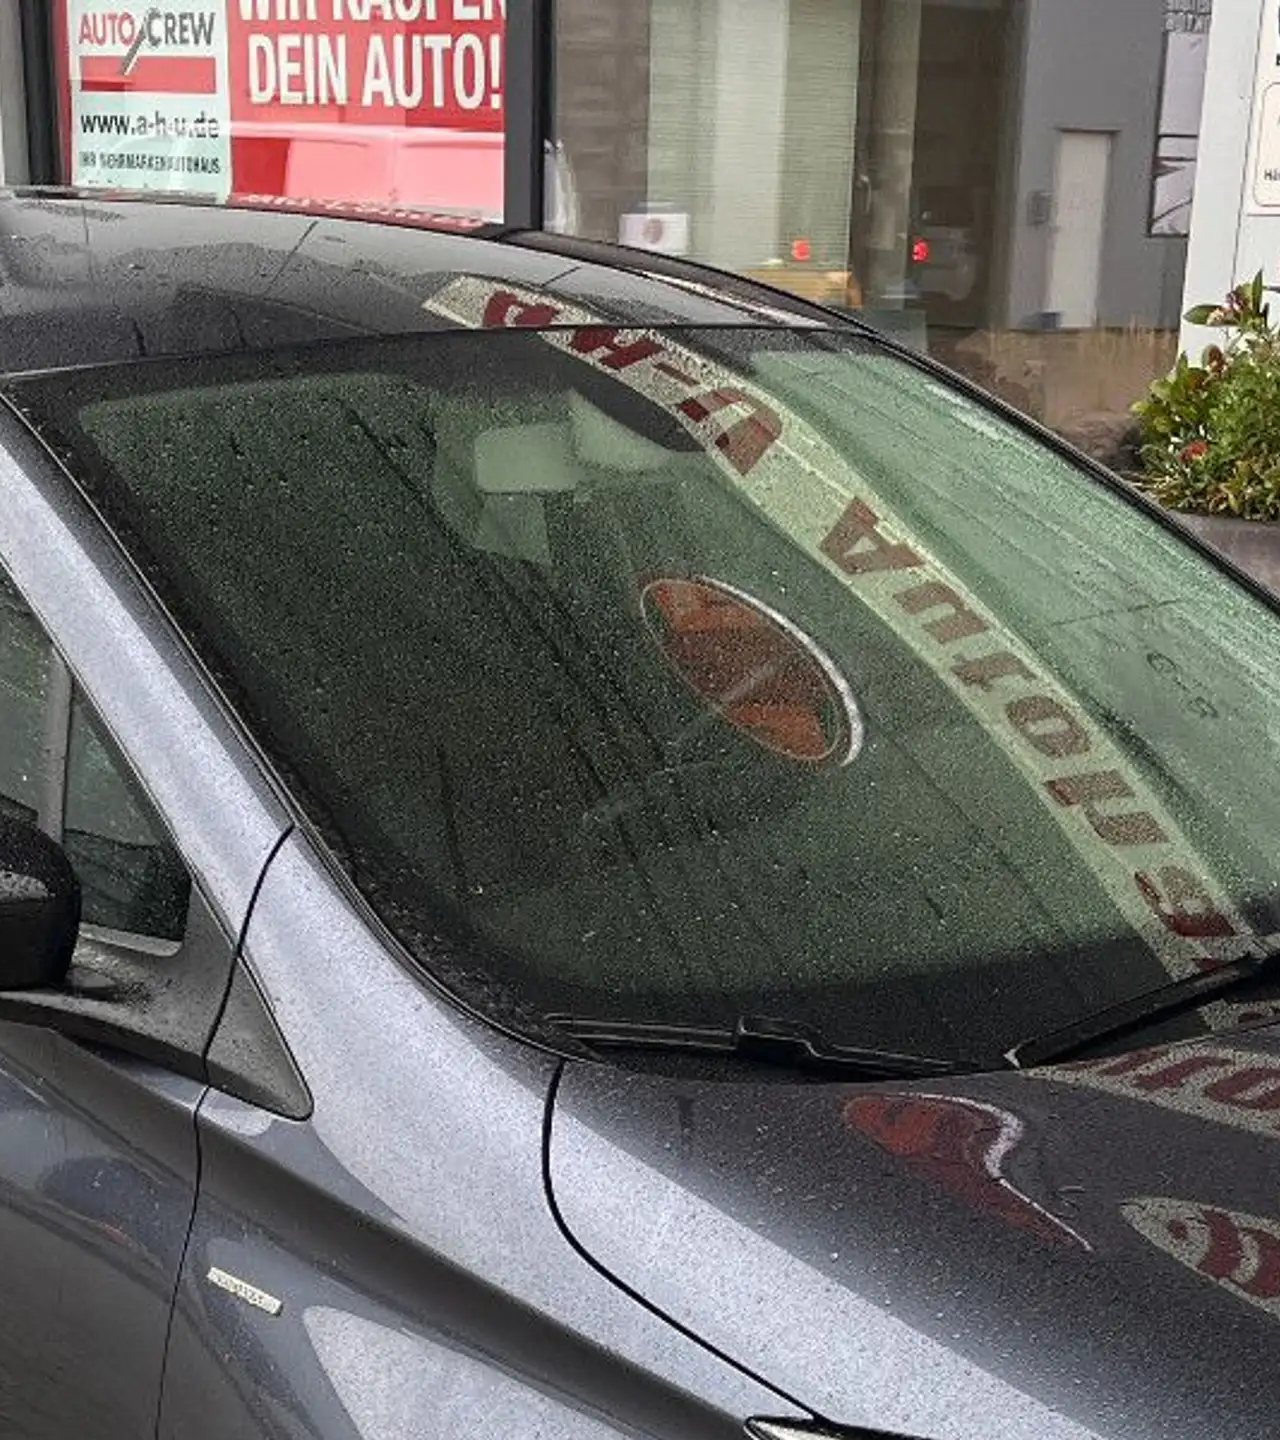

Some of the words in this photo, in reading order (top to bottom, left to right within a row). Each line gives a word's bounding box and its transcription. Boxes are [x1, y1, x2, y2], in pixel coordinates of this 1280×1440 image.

[78, 11, 135, 47] AUTO
[146, 8, 216, 48] CREW
[248, 33, 348, 105] DEIN
[361, 33, 503, 109] AUTO!
[80, 110, 219, 139] www.a-h-u.de
